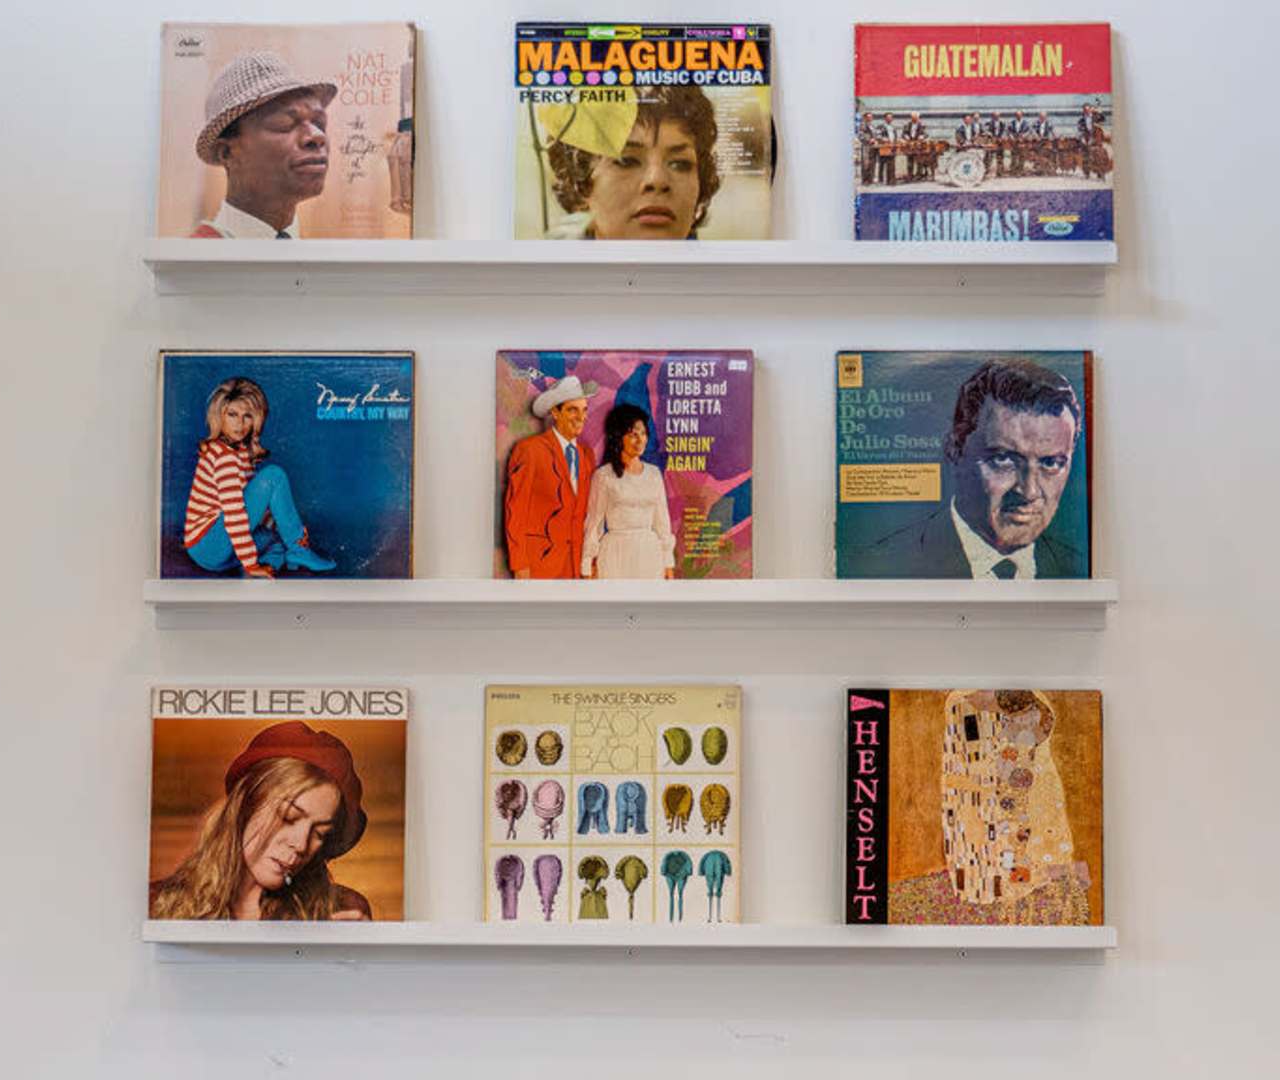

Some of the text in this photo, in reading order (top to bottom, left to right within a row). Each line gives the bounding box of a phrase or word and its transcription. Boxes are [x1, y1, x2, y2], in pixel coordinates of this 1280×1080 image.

[347, 53, 385, 69] NAT
[519, 41, 765, 71] MALAGUENA
[636, 70, 764, 85] MUSIC OF CUBA
[339, 88, 393, 106] COLE
[520, 89, 574, 103] PERCY
[579, 89, 626, 103] FAITH
[667, 362, 716, 377] ERNEST
[668, 380, 728, 395] TUBB and
[840, 390, 862, 404] El
[666, 399, 722, 415] LORETTA
[840, 404, 906, 419] De Oro
[665, 418, 699, 433] LYNN
[841, 420, 867, 434] De
[666, 436, 715, 452] SINGIN'
[840, 435, 942, 449] Julio Sosa
[667, 456, 706, 471] AGAIN
[159, 689, 404, 716] RICKIE LEE JONES
[552, 692, 677, 706] THE SWINGLE SINGERS
[853, 719, 880, 921] HENSELT
